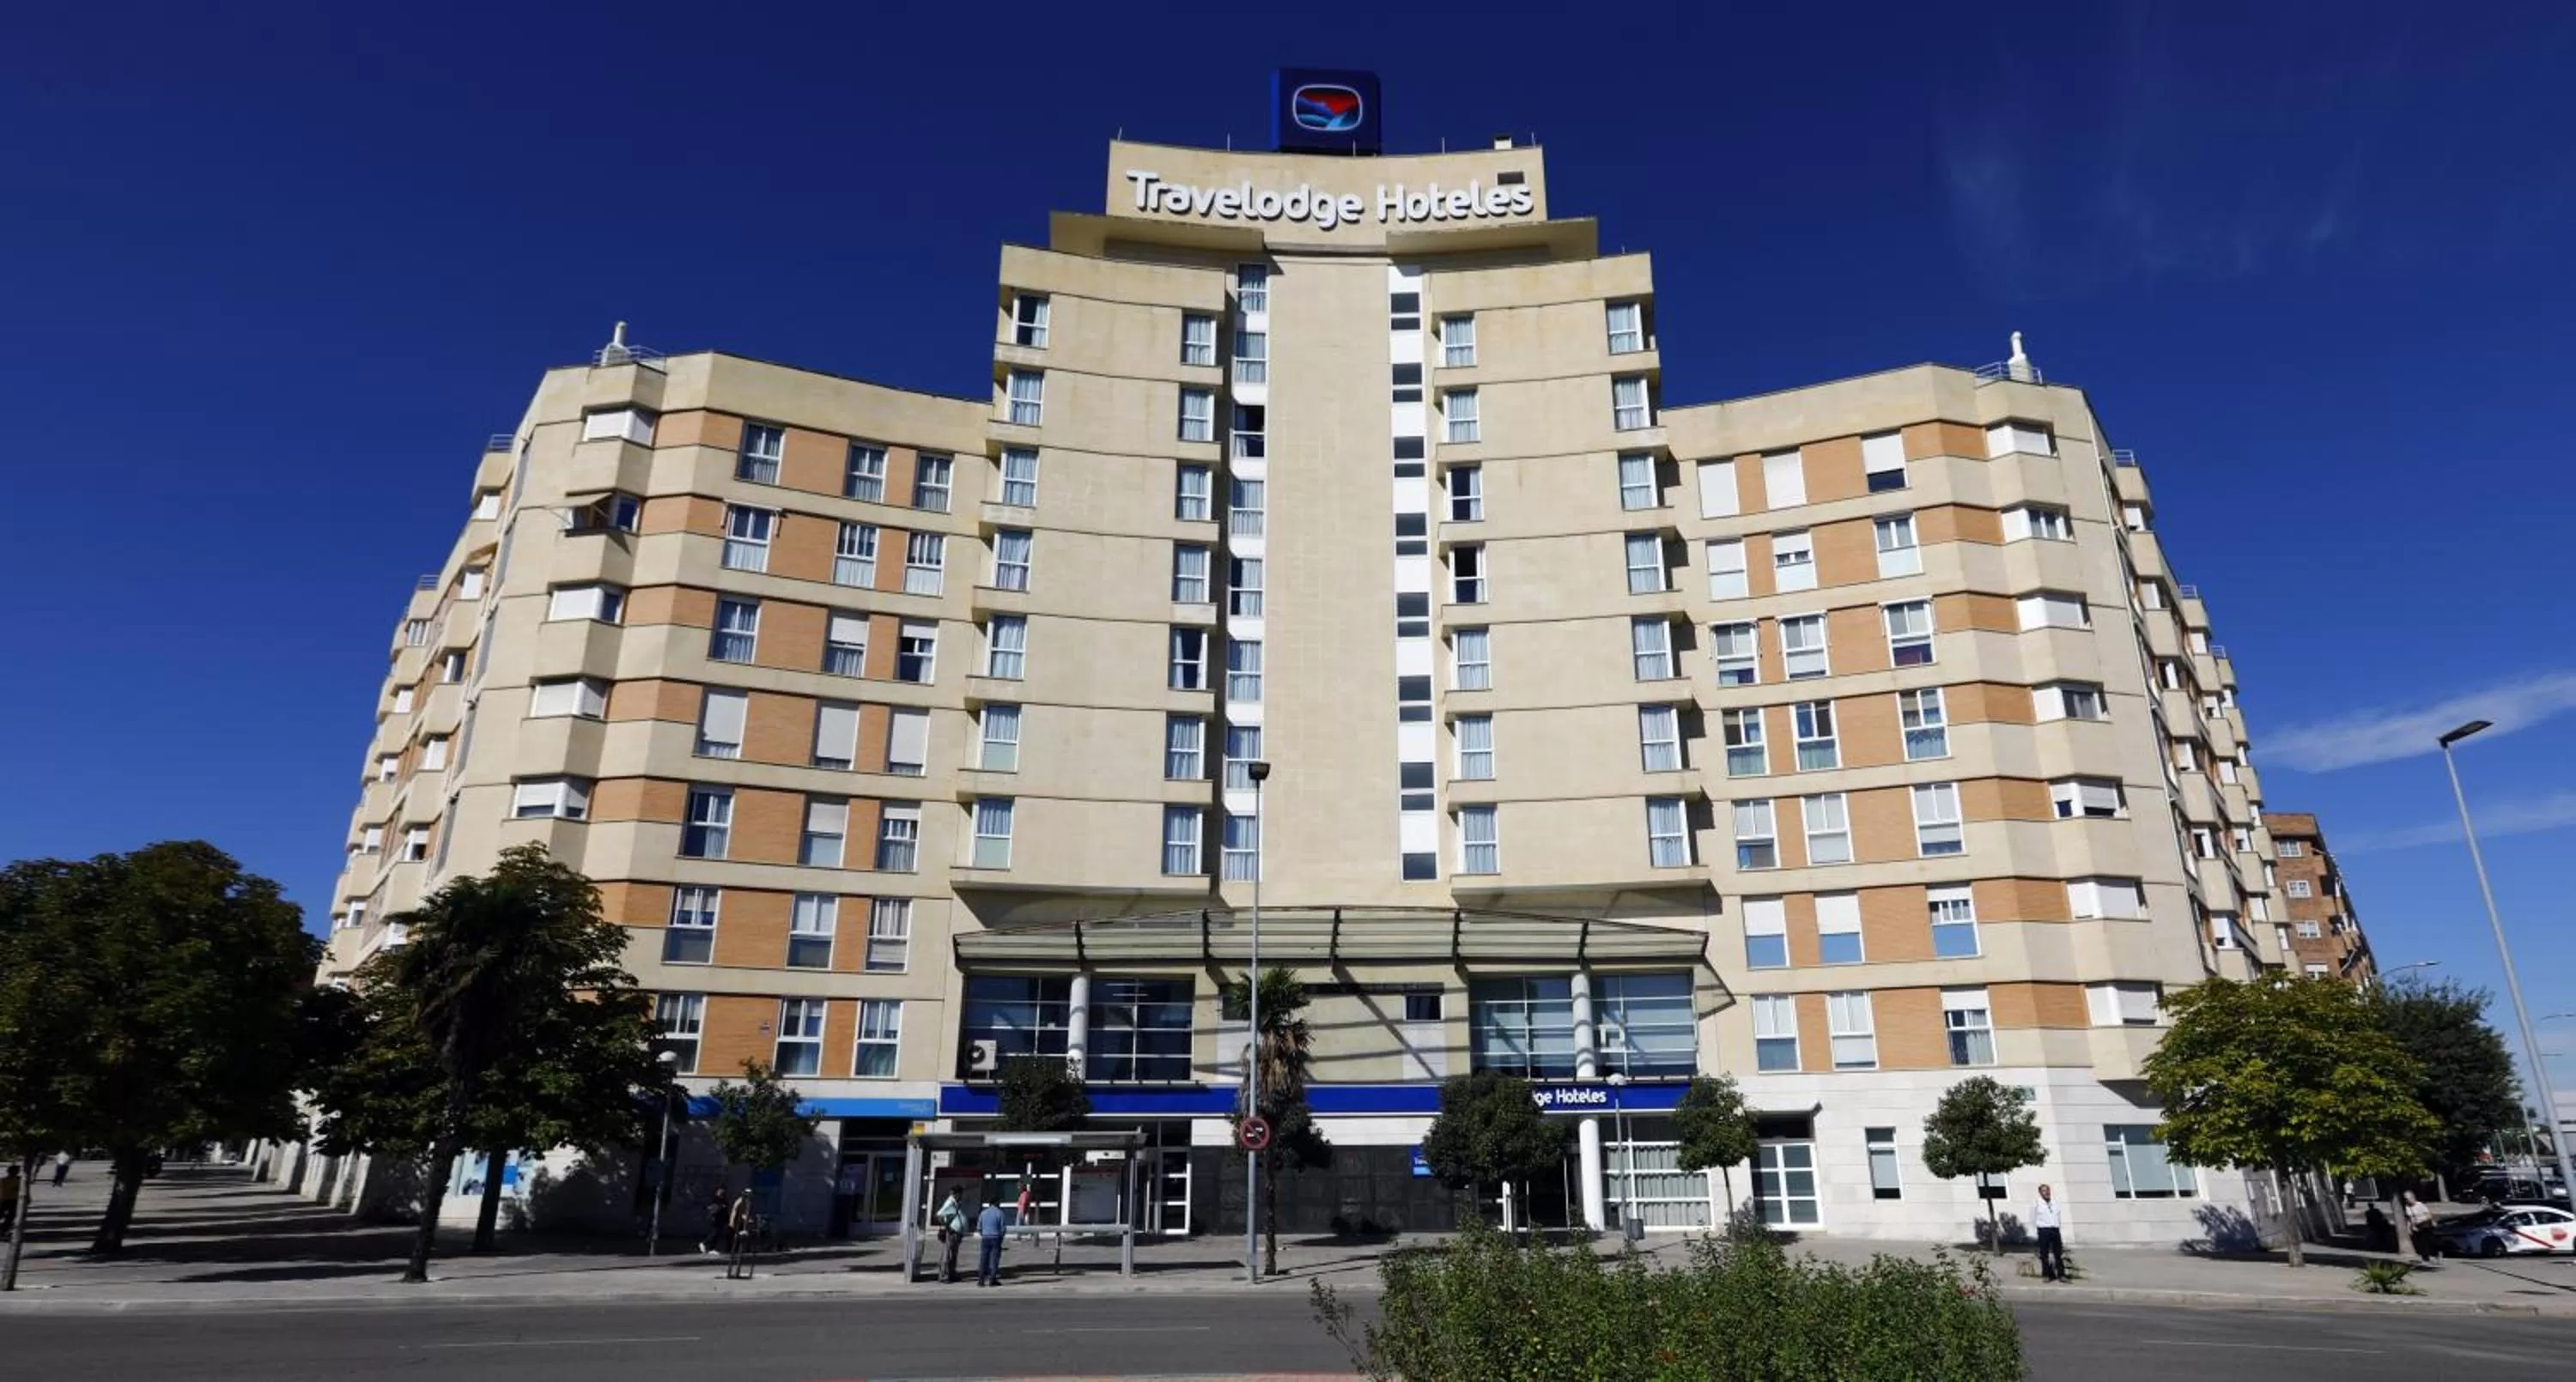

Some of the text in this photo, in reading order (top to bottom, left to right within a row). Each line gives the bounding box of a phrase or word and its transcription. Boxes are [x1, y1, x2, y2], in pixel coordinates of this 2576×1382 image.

[1127, 169, 1534, 229] Travelodge Hoteles
[1555, 1088, 1607, 1104] Hoteles
